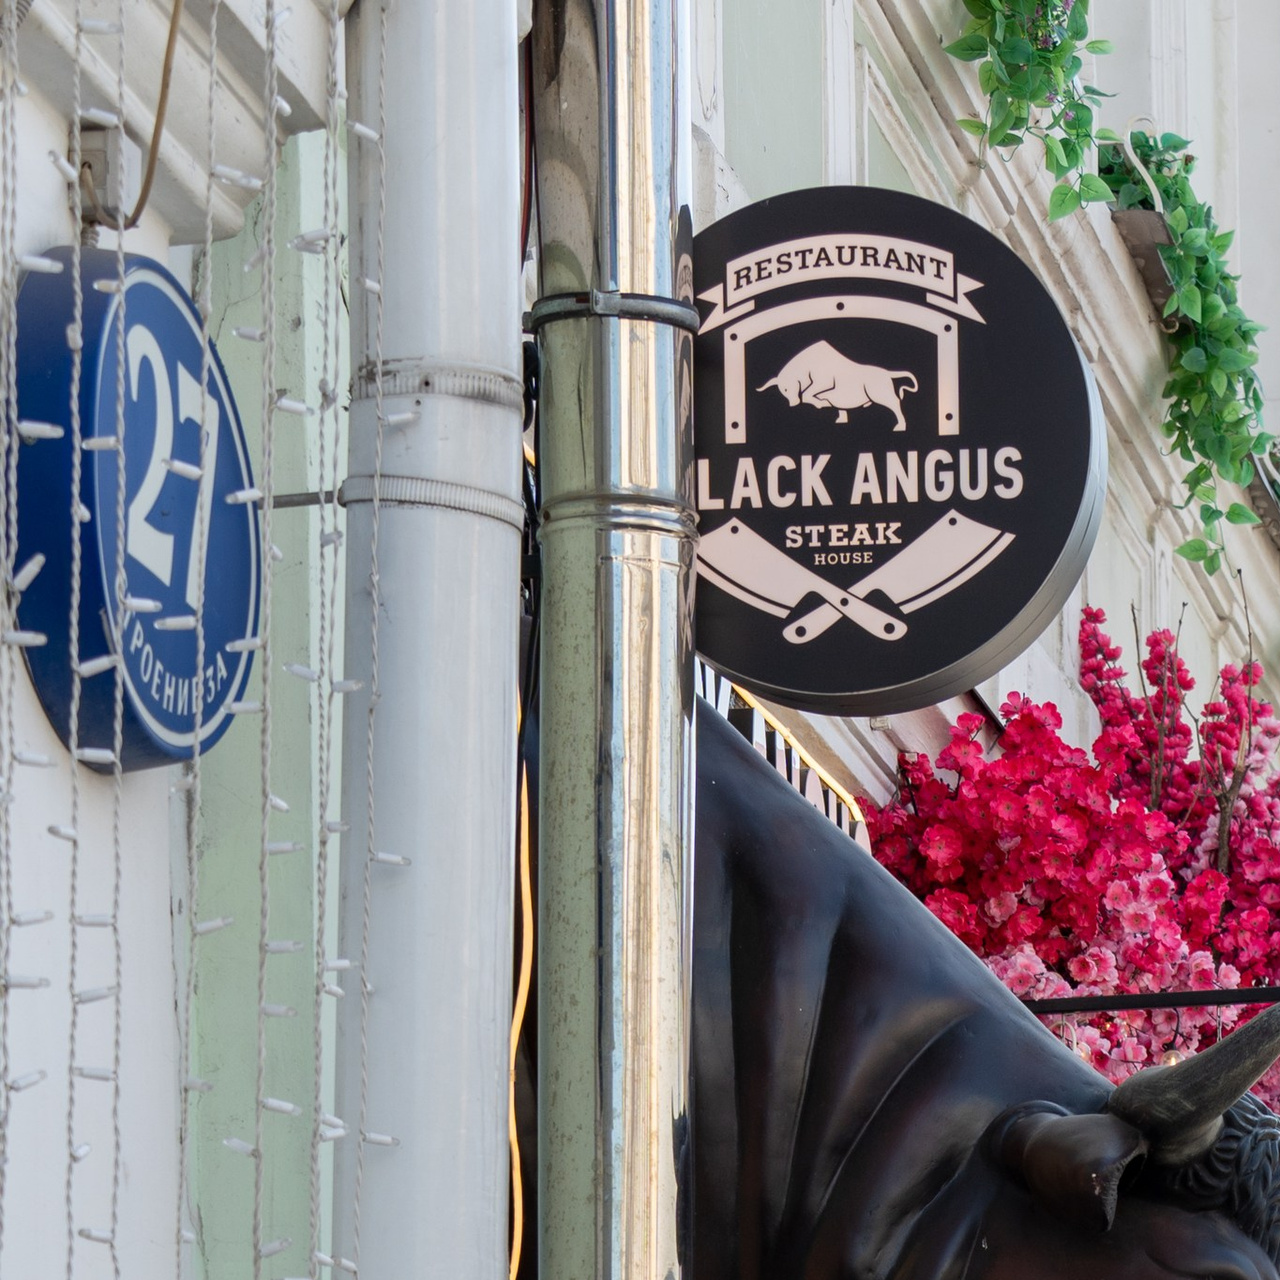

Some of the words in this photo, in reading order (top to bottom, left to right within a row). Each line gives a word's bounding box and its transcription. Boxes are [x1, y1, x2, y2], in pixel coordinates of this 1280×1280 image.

[733, 245, 947, 291] RESTAURANT
[127, 323, 219, 612] 27
[697, 453, 833, 510] LACK
[850, 446, 1024, 505] ANGUS
[785, 522, 902, 548] STEAK
[814, 552, 873, 566] HOUSE
